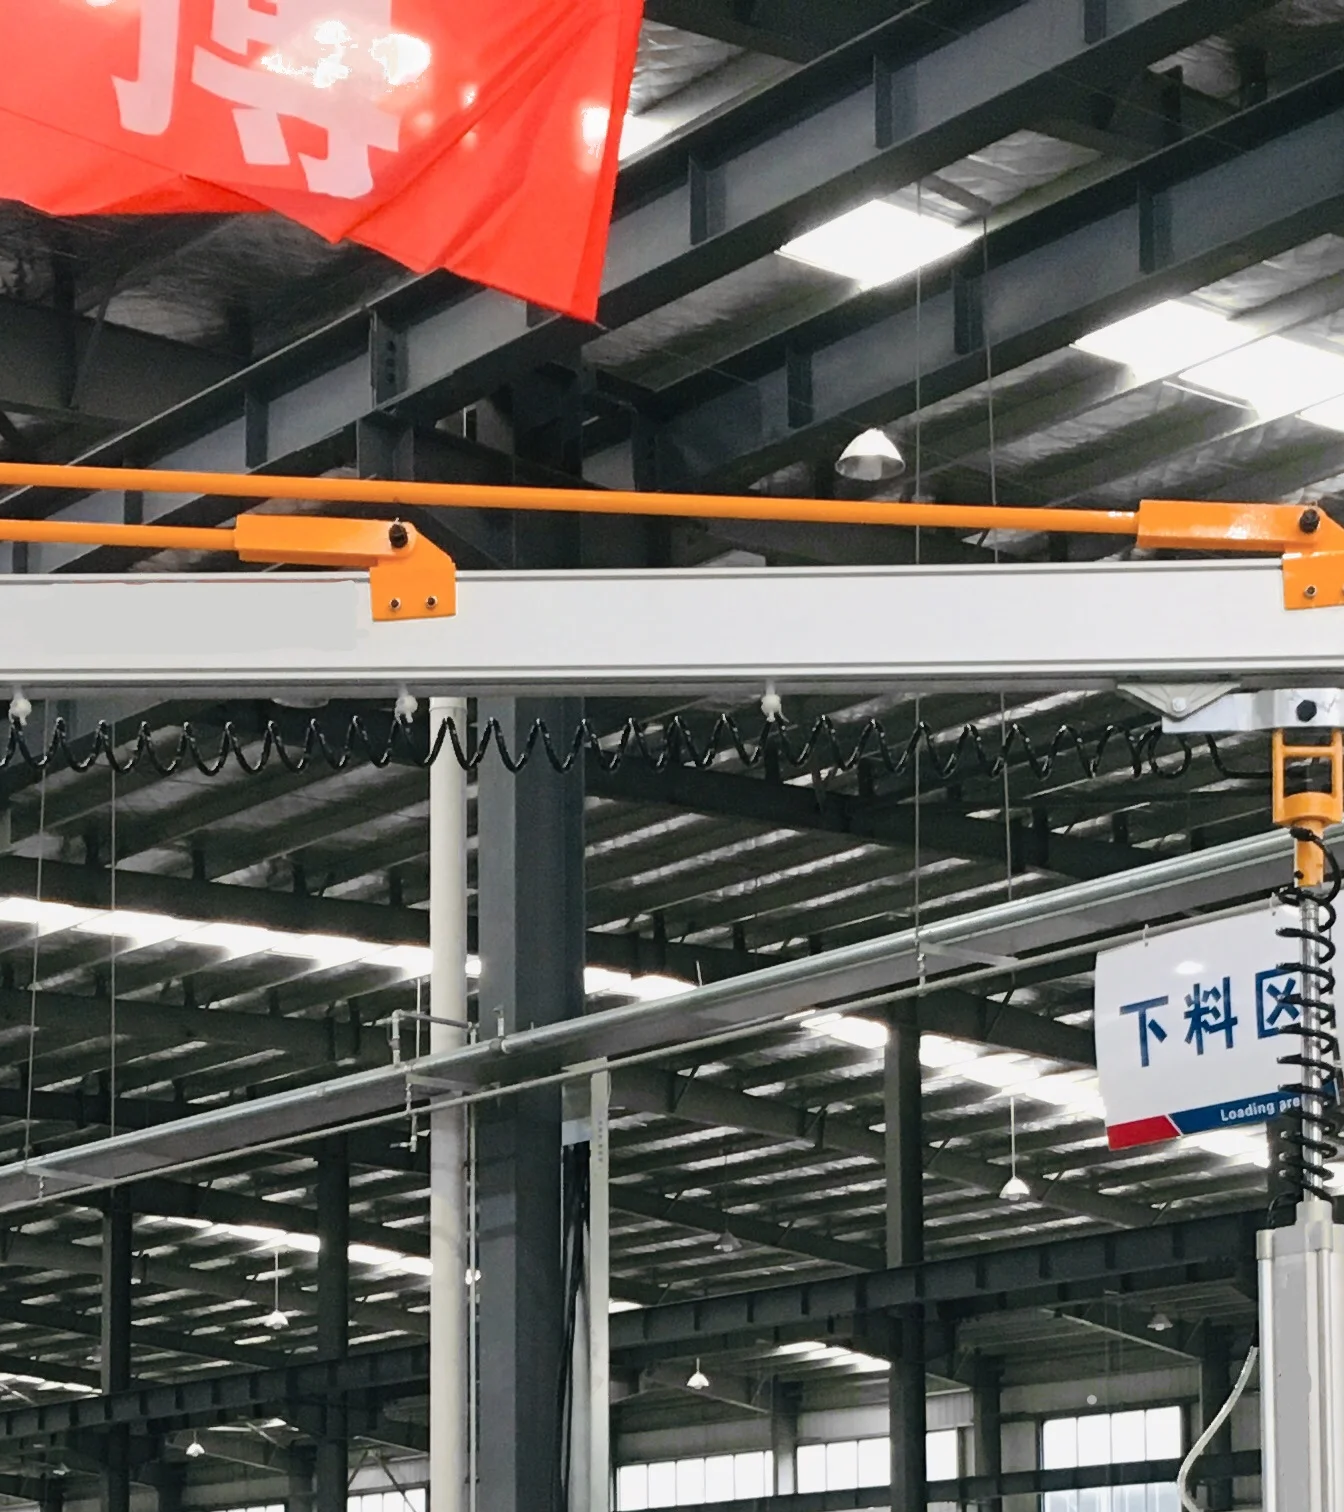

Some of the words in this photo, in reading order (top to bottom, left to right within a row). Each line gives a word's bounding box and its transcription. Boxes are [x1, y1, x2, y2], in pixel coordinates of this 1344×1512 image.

[1119, 968, 1304, 1068] 下料区
[1220, 1102, 1275, 1122] Loading
[1278, 1096, 1301, 1113] are
